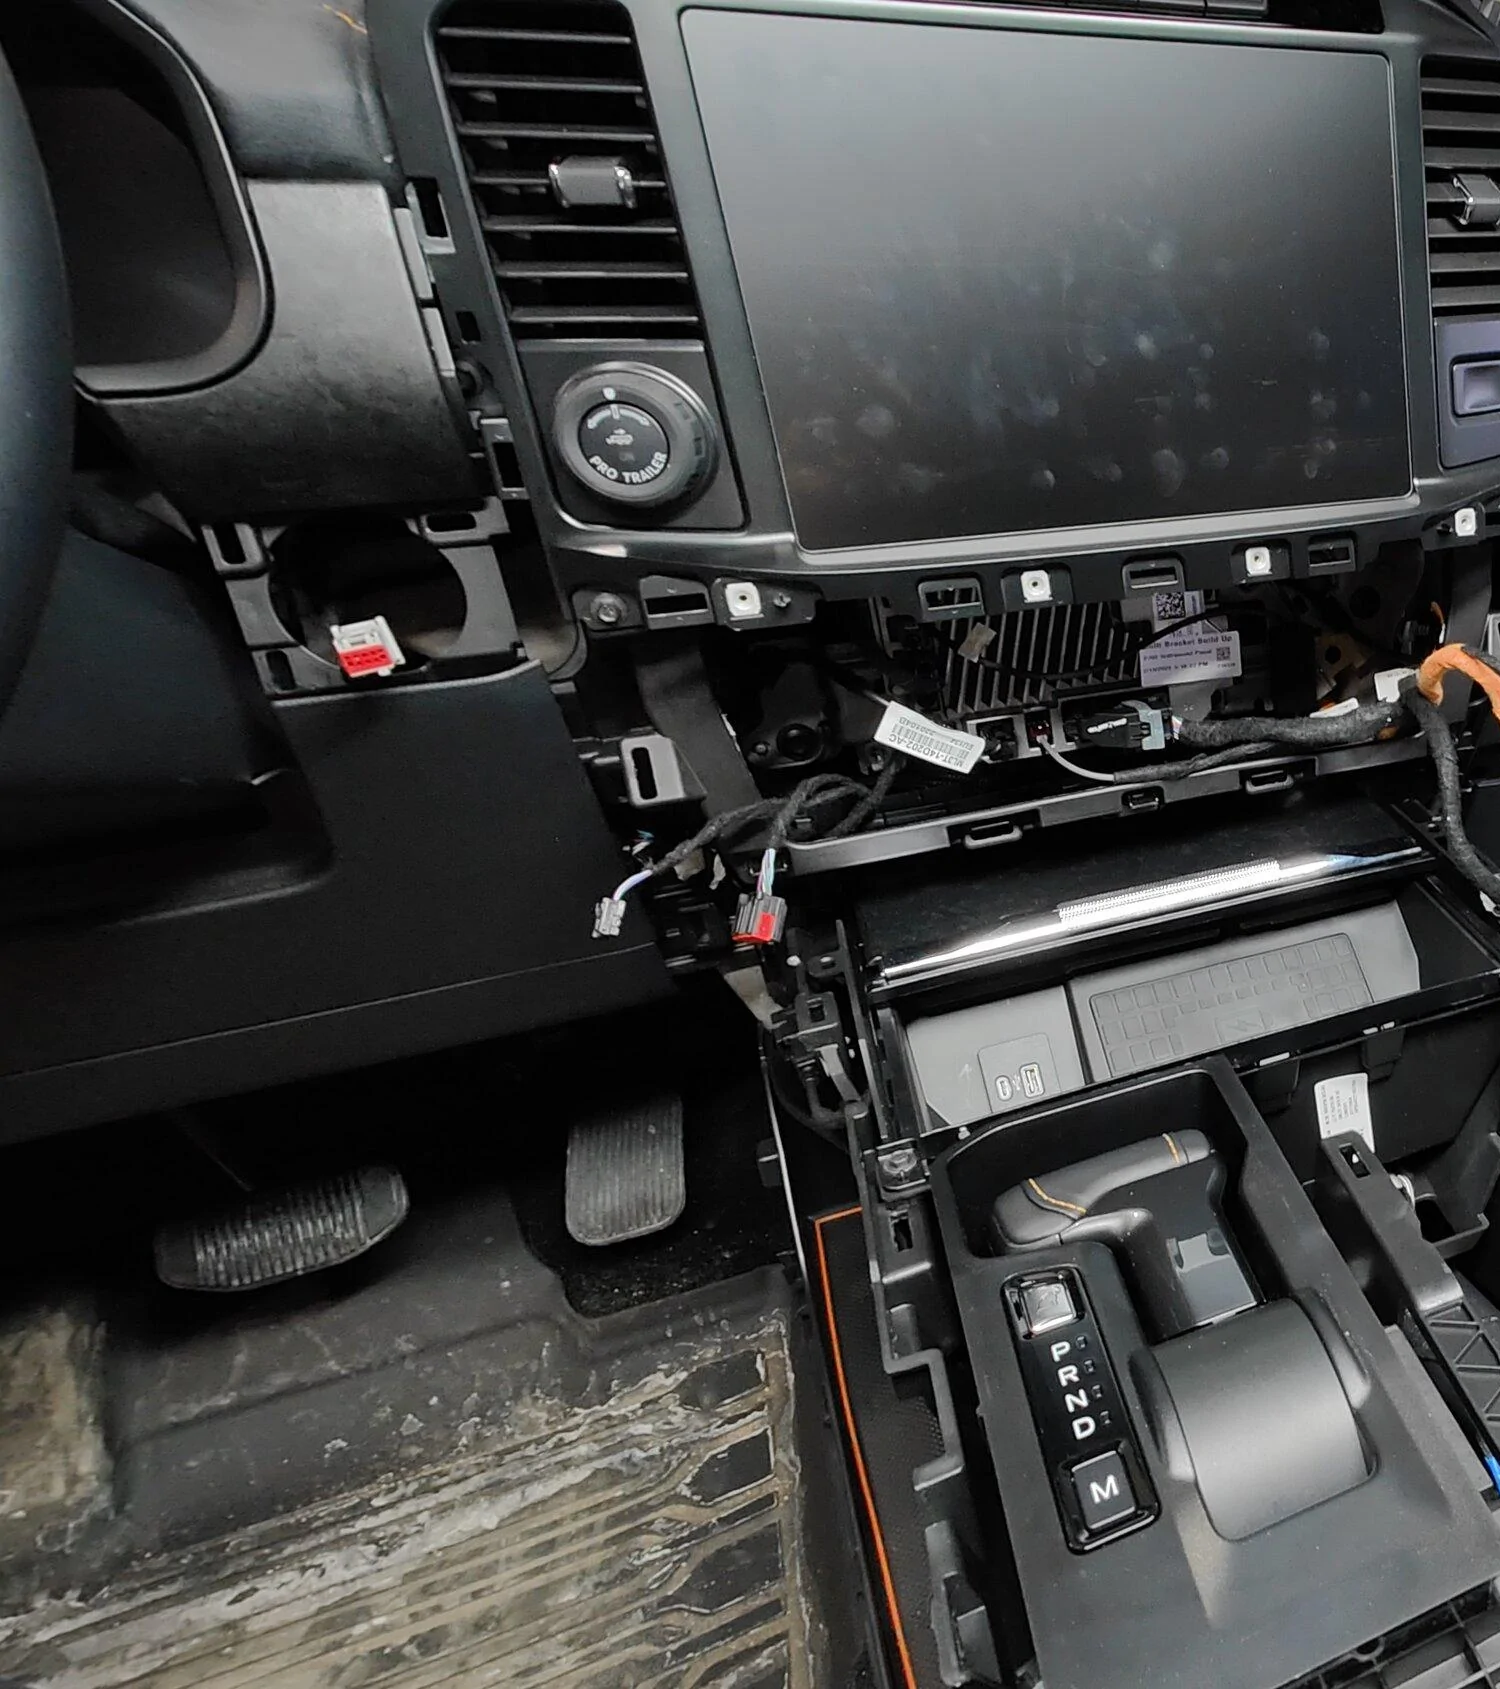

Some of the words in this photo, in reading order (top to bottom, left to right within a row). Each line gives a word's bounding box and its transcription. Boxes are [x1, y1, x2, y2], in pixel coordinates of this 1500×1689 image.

[589, 455, 619, 480] PRO
[621, 451, 668, 484] TRAILER
[1050, 1340, 1071, 1363] P
[1057, 1364, 1080, 1387] R
[1064, 1388, 1089, 1413] N
[1072, 1415, 1096, 1440] D
[1089, 1474, 1120, 1505] M
